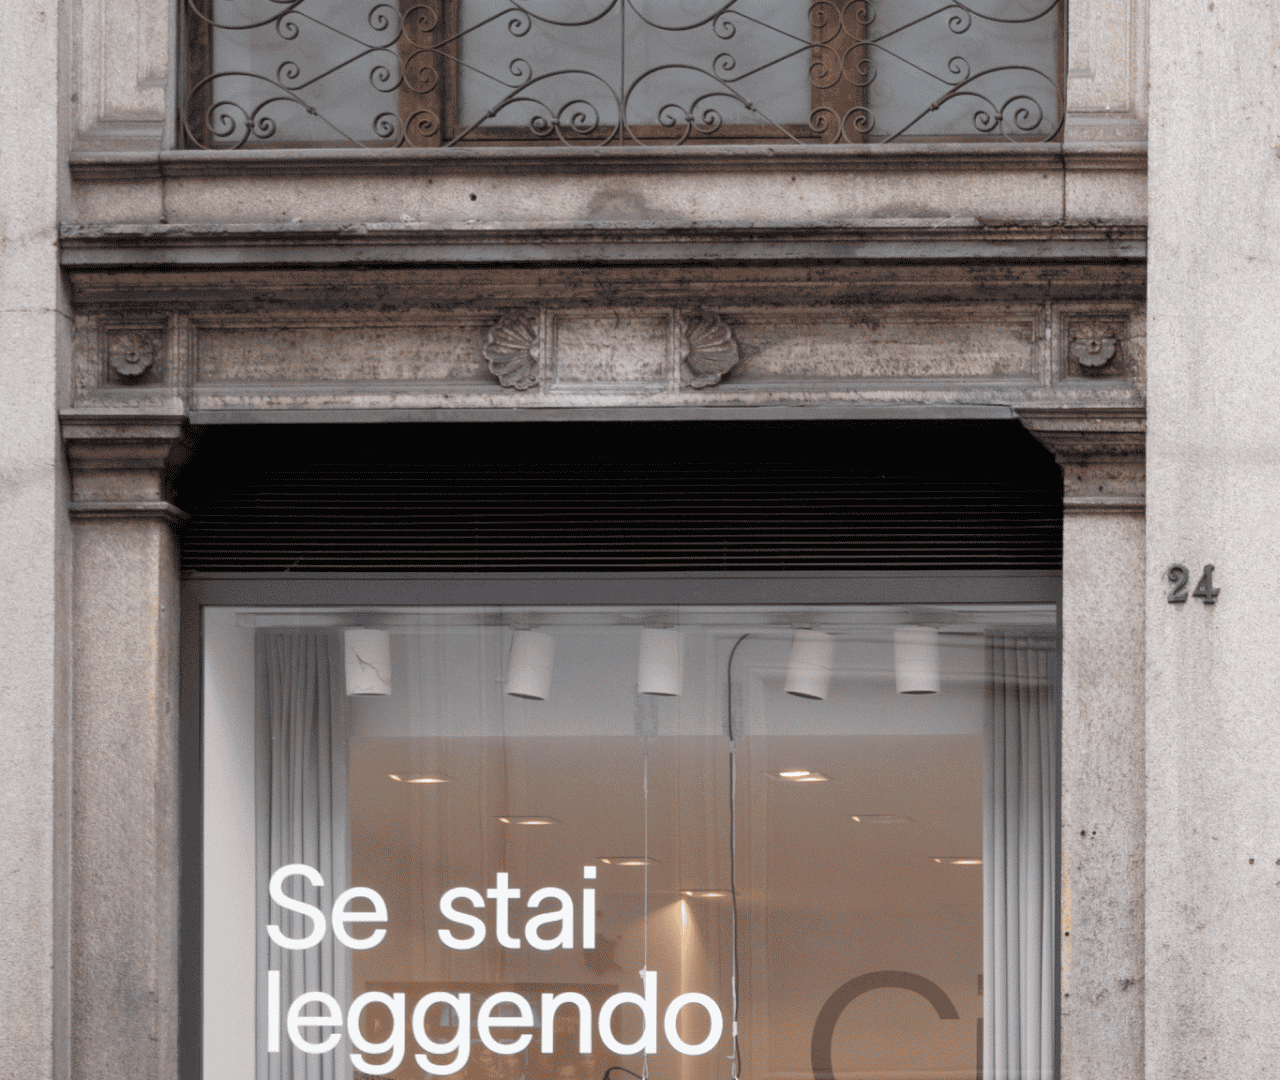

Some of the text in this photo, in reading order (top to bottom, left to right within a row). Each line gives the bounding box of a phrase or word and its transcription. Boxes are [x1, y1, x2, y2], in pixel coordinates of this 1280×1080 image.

[1167, 563, 1221, 605] 24
[267, 864, 596, 950] Se stai
[268, 970, 723, 1076] leggendo
